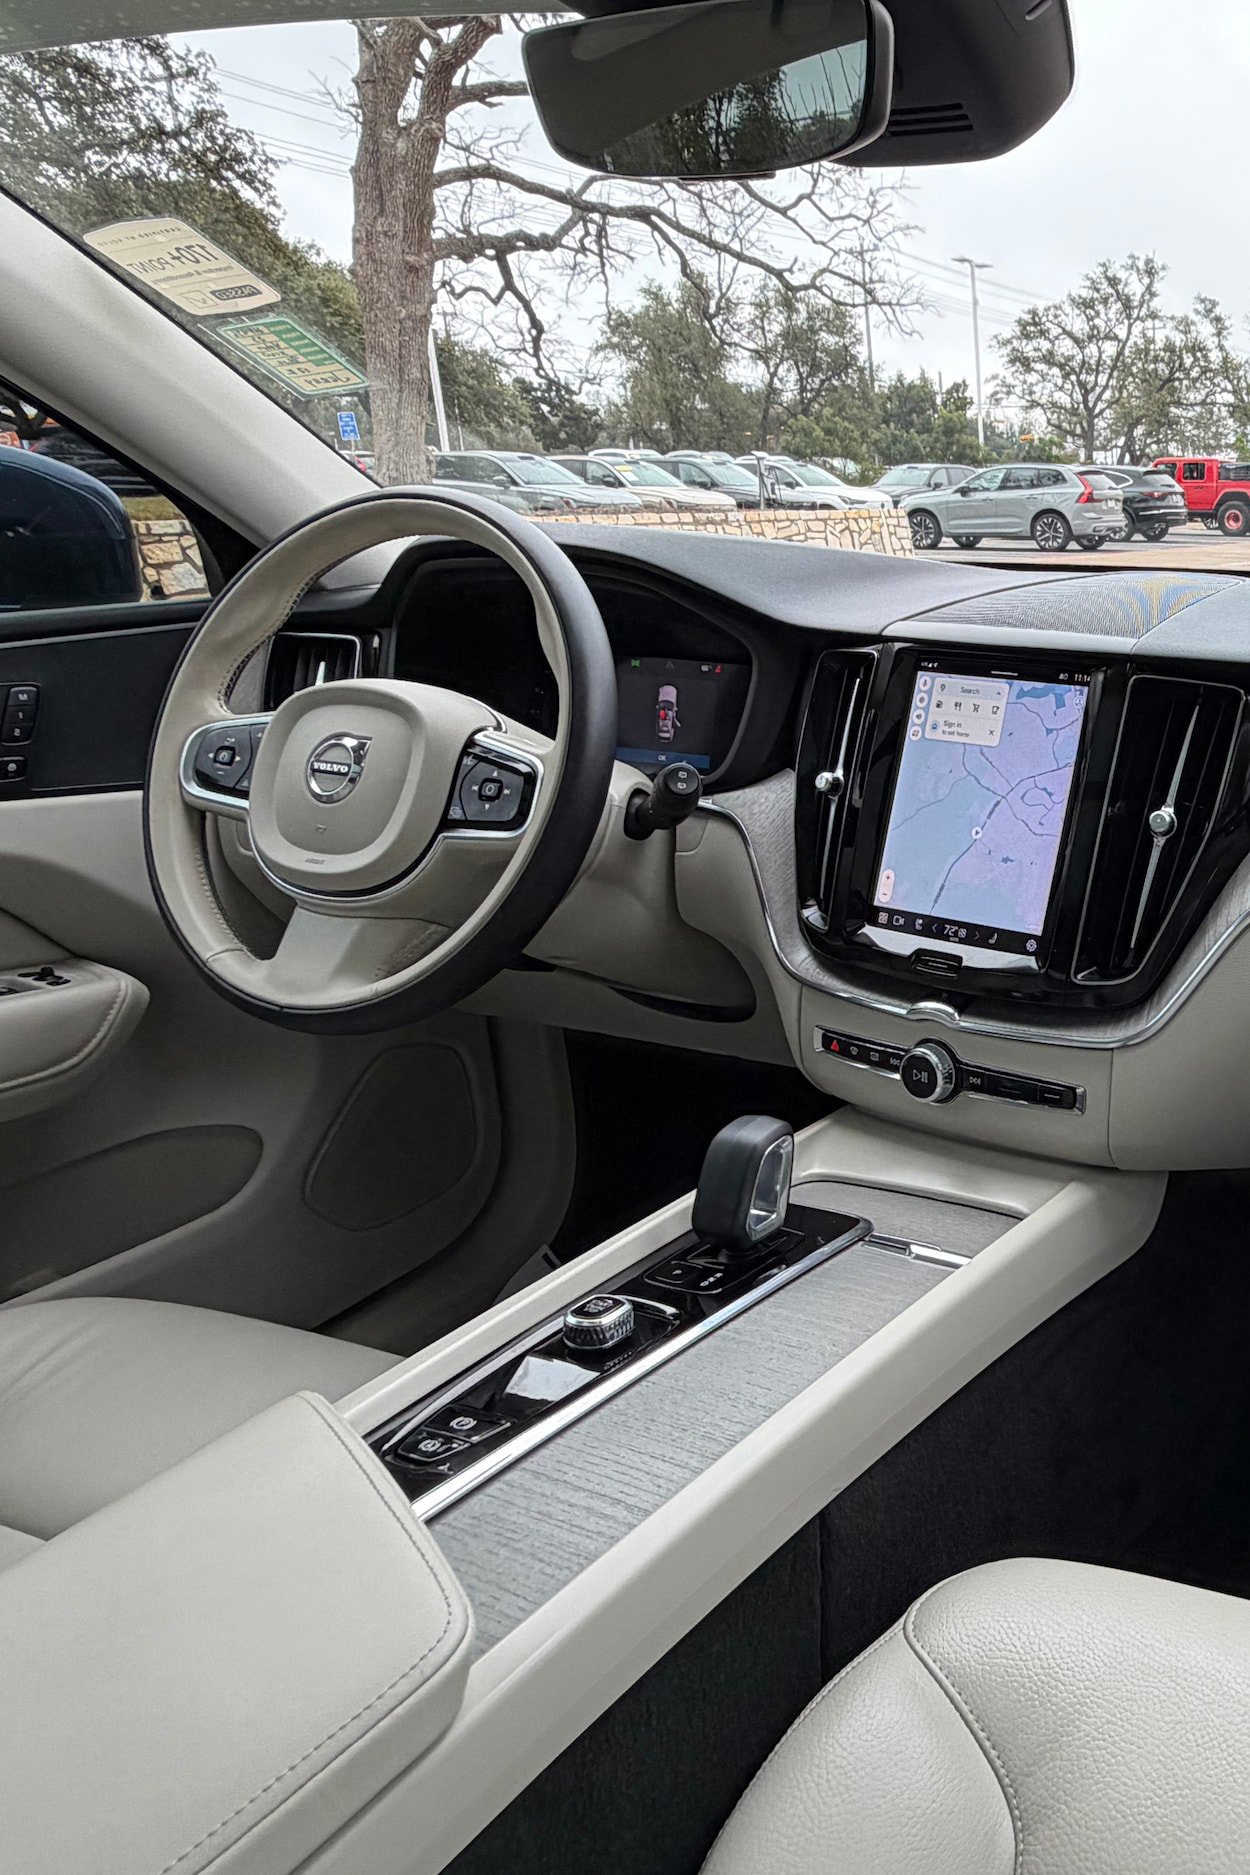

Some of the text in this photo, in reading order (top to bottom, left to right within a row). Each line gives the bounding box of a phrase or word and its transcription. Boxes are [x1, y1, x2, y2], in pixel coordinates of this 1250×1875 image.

[960, 686, 980, 695] Search
[943, 720, 962, 729] Sign in
[313, 761, 349, 773] VOLVO
